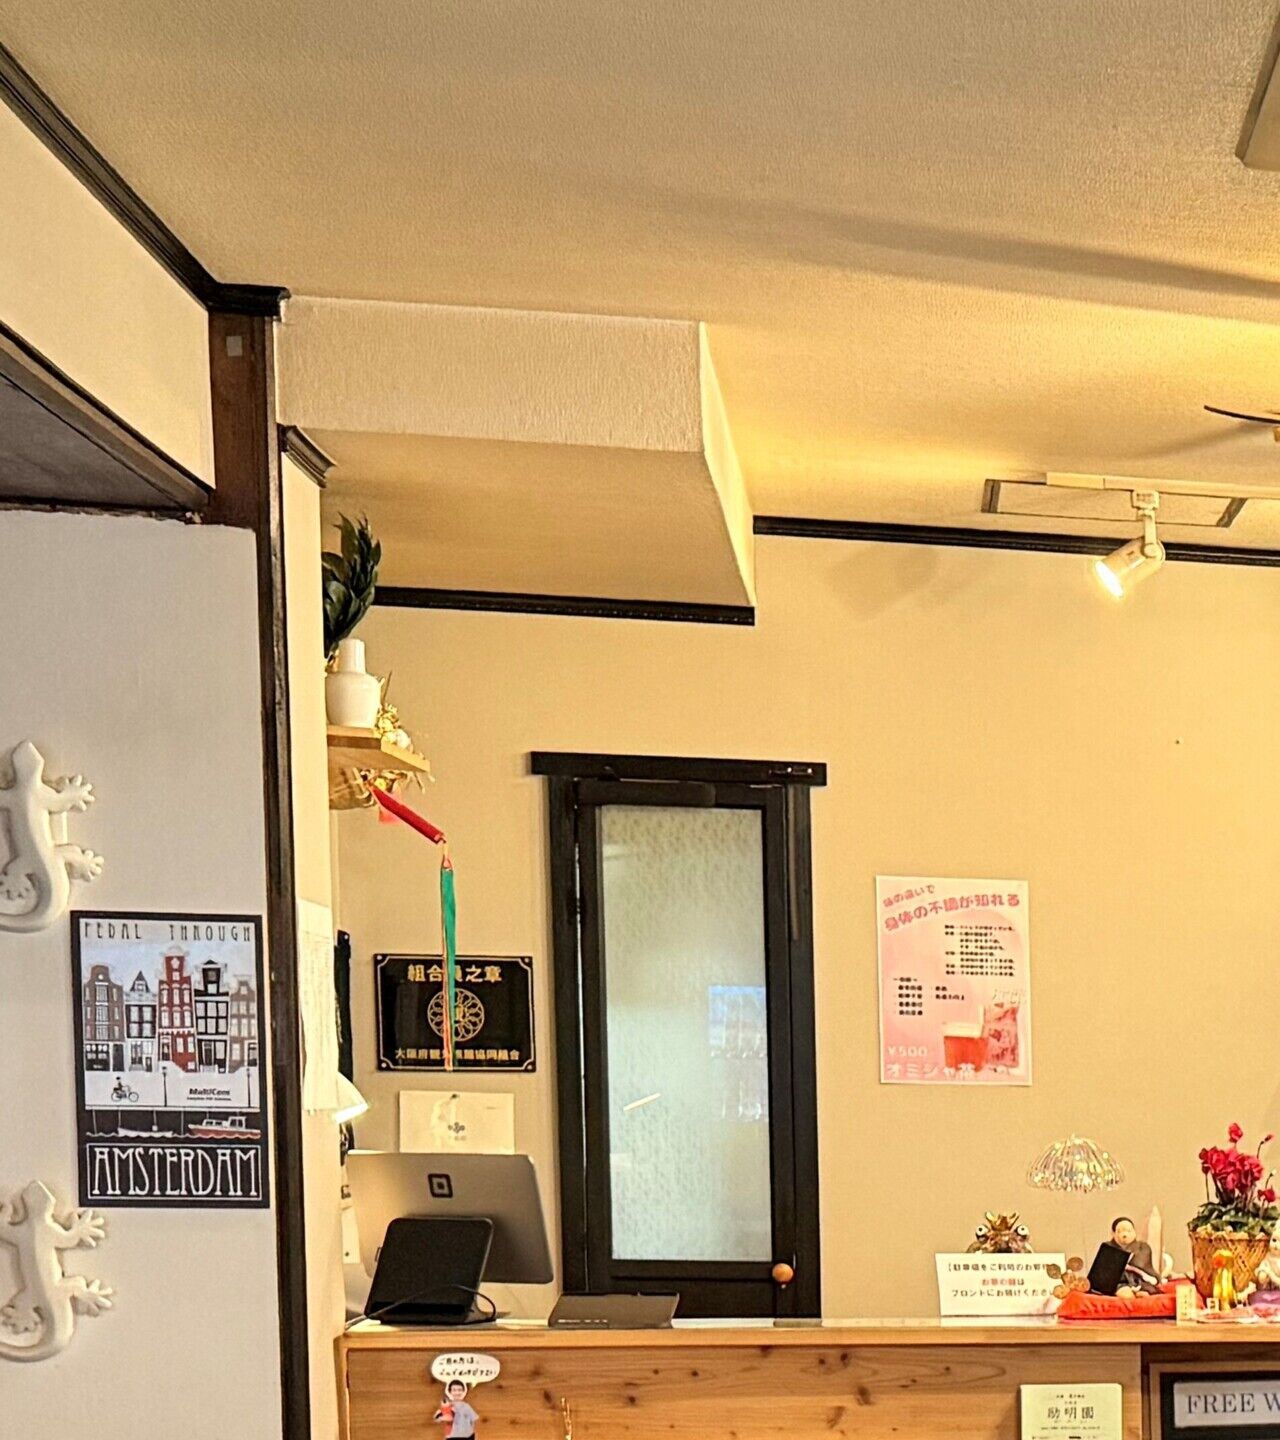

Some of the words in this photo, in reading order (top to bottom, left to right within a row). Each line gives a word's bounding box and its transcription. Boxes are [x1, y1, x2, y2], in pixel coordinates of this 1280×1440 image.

[884, 893, 1020, 931] 身体の不調が知れる
[169, 923, 251, 942] THROUGH
[92, 1147, 258, 1197] AMSTERDAM
[1187, 1392, 1255, 1414] FREE
